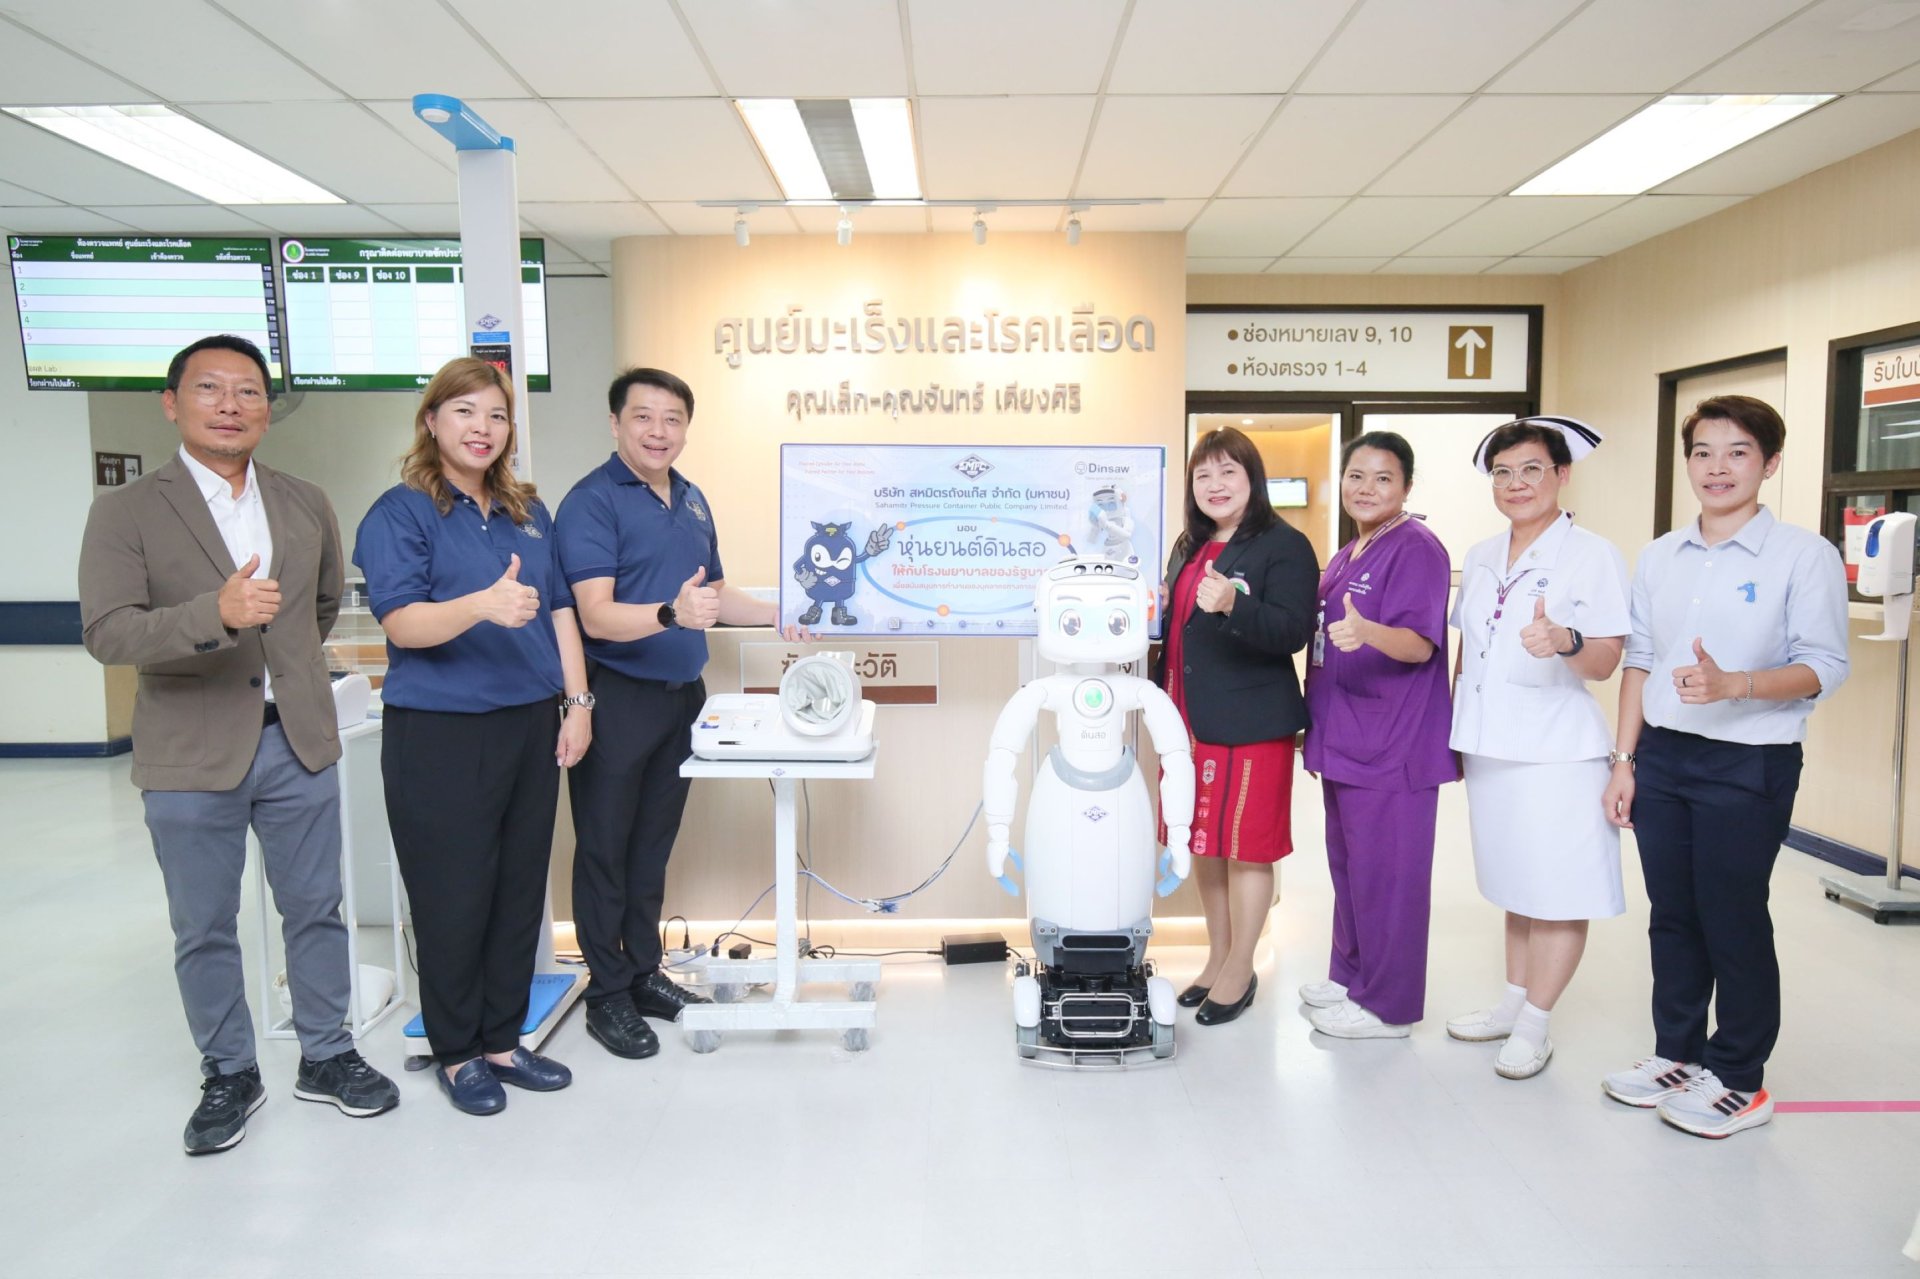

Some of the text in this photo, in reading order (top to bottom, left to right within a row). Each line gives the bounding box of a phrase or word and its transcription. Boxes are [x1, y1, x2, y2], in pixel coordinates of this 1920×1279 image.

[18, 266, 23, 274] 1
[311, 271, 317, 280] 1
[353, 271, 360, 280] 9
[395, 271, 406, 280] 10
[20, 282, 25, 291] 2
[24, 315, 30, 323] 4
[714, 299, 1155, 369] ศูนย์มะเร็งและโรคเลือด
[1243, 322, 1412, 345] ช่องหมายเลข 9, 10
[1242, 357, 1367, 377] ห้องตรวจ 1-4
[1088, 462, 1130, 474] Dinsaw
[874, 486, 1070, 501] บริษัท สหมิตรถังแก๊ส จำกัด (มหาชน)
[1004, 503, 1037, 511] Company
[957, 524, 977, 532] มอบ
[897, 534, 1046, 562] หุ่นยนต์ดินสอ
